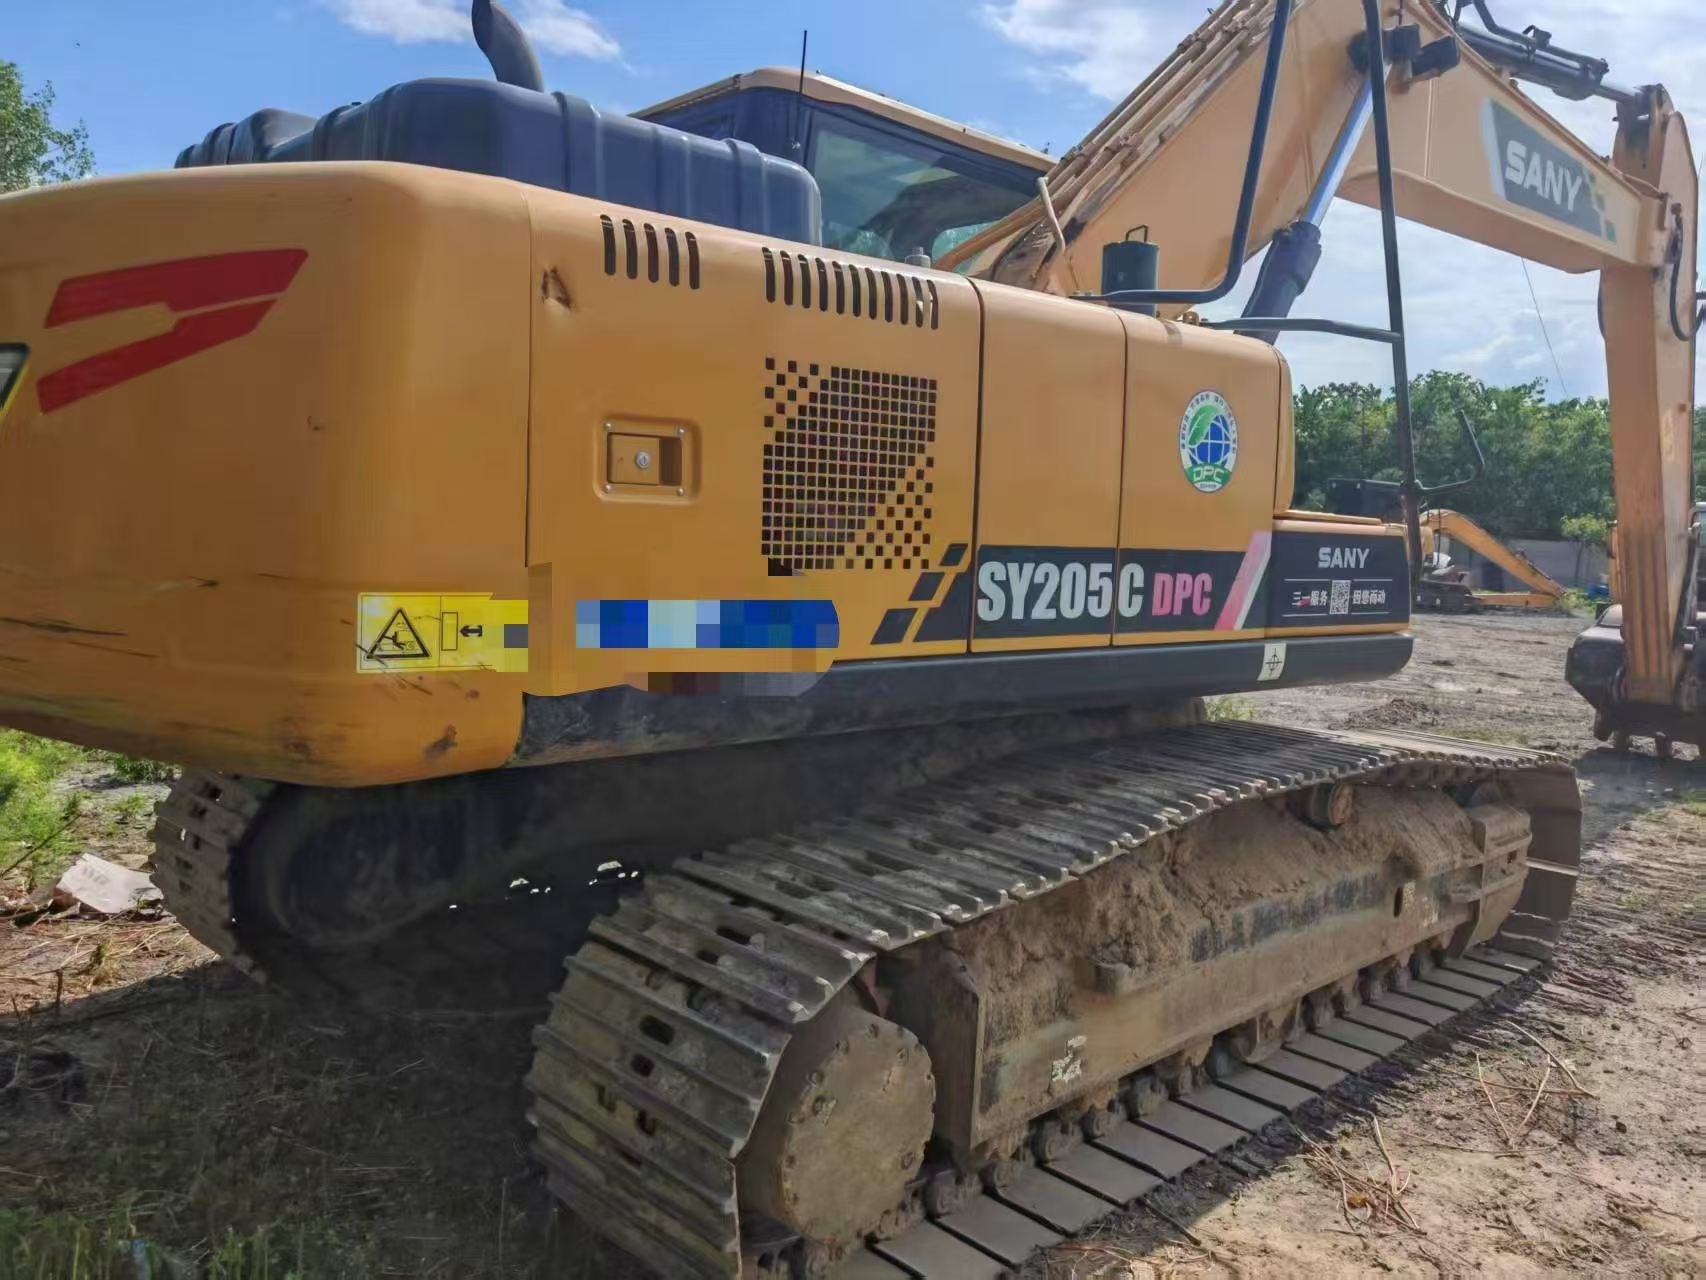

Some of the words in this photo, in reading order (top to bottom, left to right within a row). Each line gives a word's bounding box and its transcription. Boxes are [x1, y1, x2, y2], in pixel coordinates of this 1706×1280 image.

[1504, 139, 1583, 212] SANY
[1317, 546, 1371, 569] SANY
[1151, 572, 1213, 616] DPC
